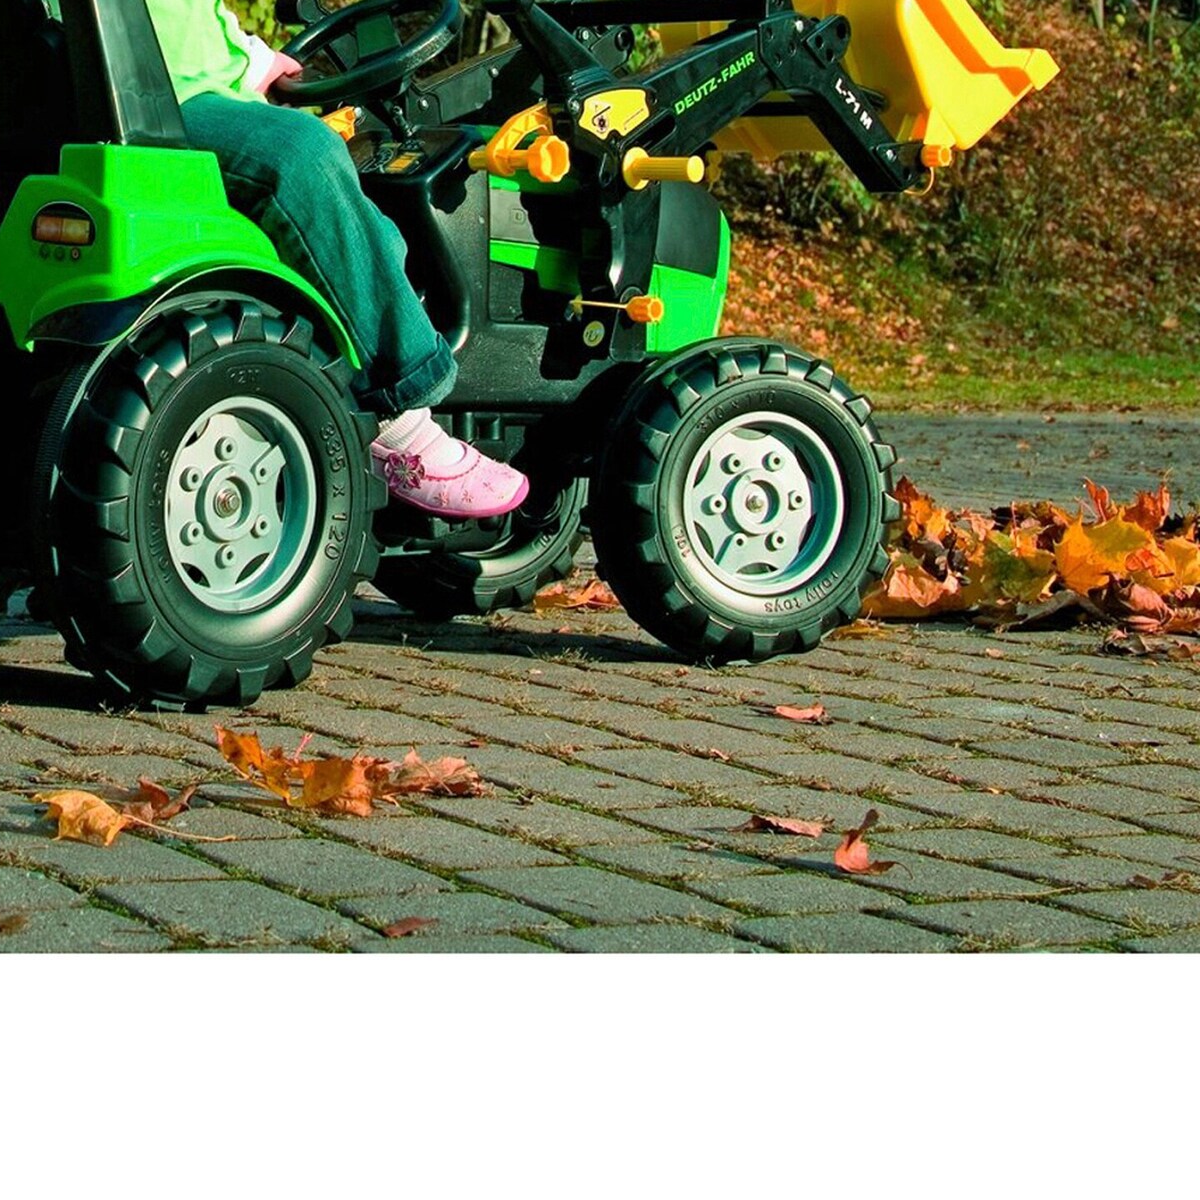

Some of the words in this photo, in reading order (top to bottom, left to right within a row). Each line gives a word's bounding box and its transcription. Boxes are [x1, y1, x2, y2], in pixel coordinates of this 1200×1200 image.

[673, 50, 756, 116] DEUTZ-FAHR
[324, 512, 348, 560] 120
[763, 597, 803, 613] toys
[804, 570, 839, 603] rolly
